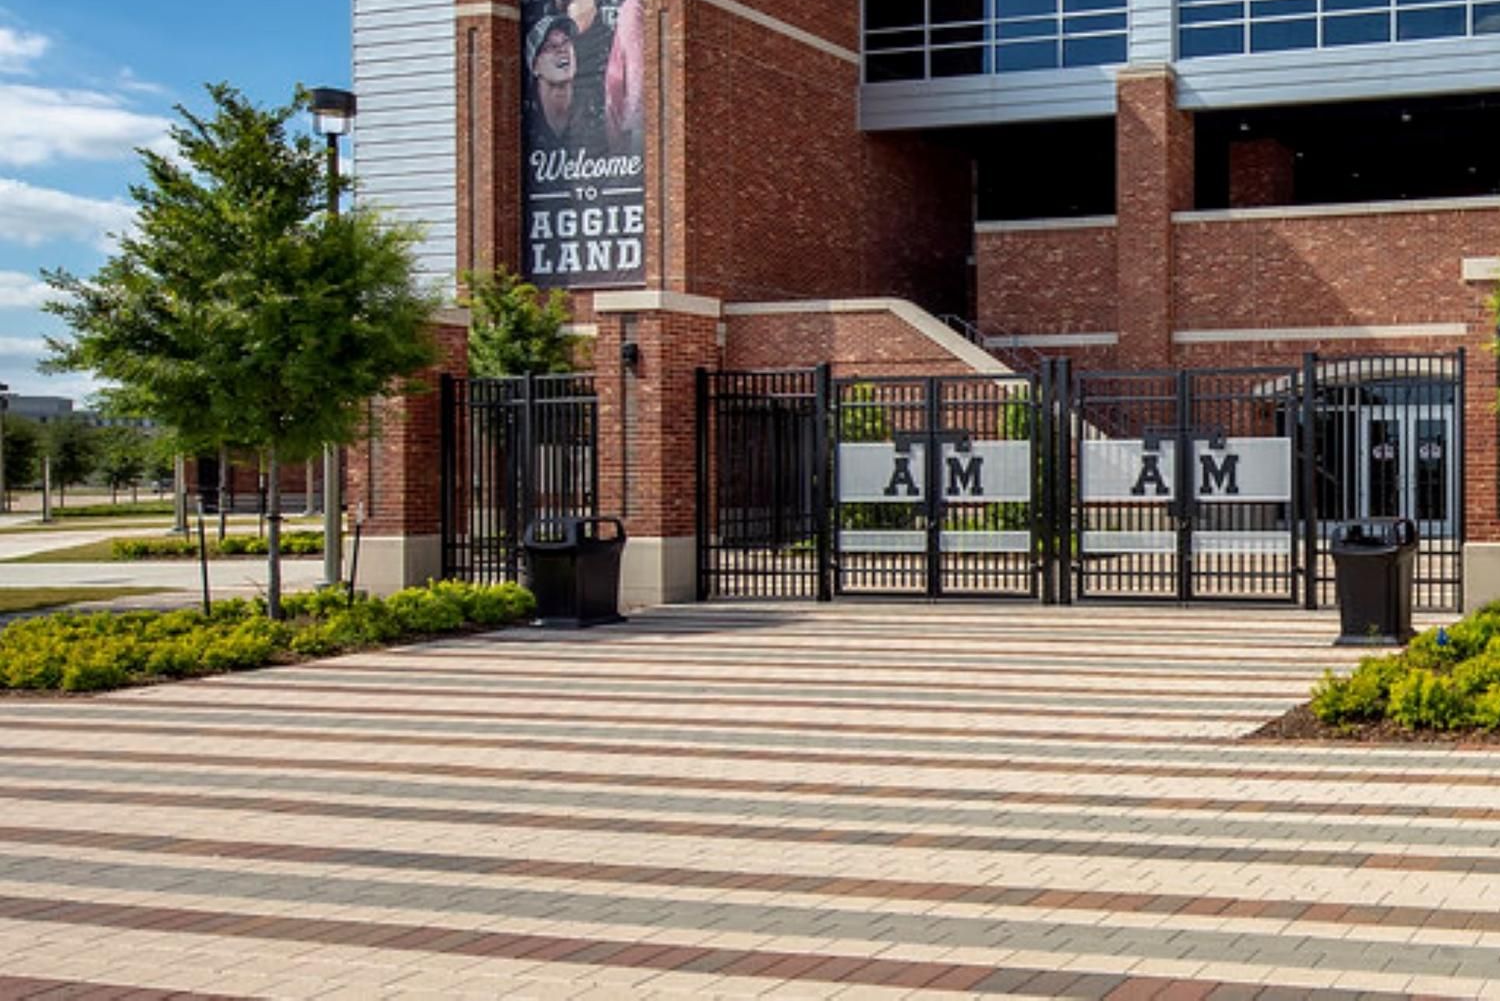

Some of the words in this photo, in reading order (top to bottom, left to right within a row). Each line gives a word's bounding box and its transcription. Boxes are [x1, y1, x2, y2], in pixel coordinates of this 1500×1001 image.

[530, 148, 643, 182] Welcome
[575, 185, 598, 200] TO
[529, 205, 644, 239] AGGIE
[532, 238, 641, 274] LAND
